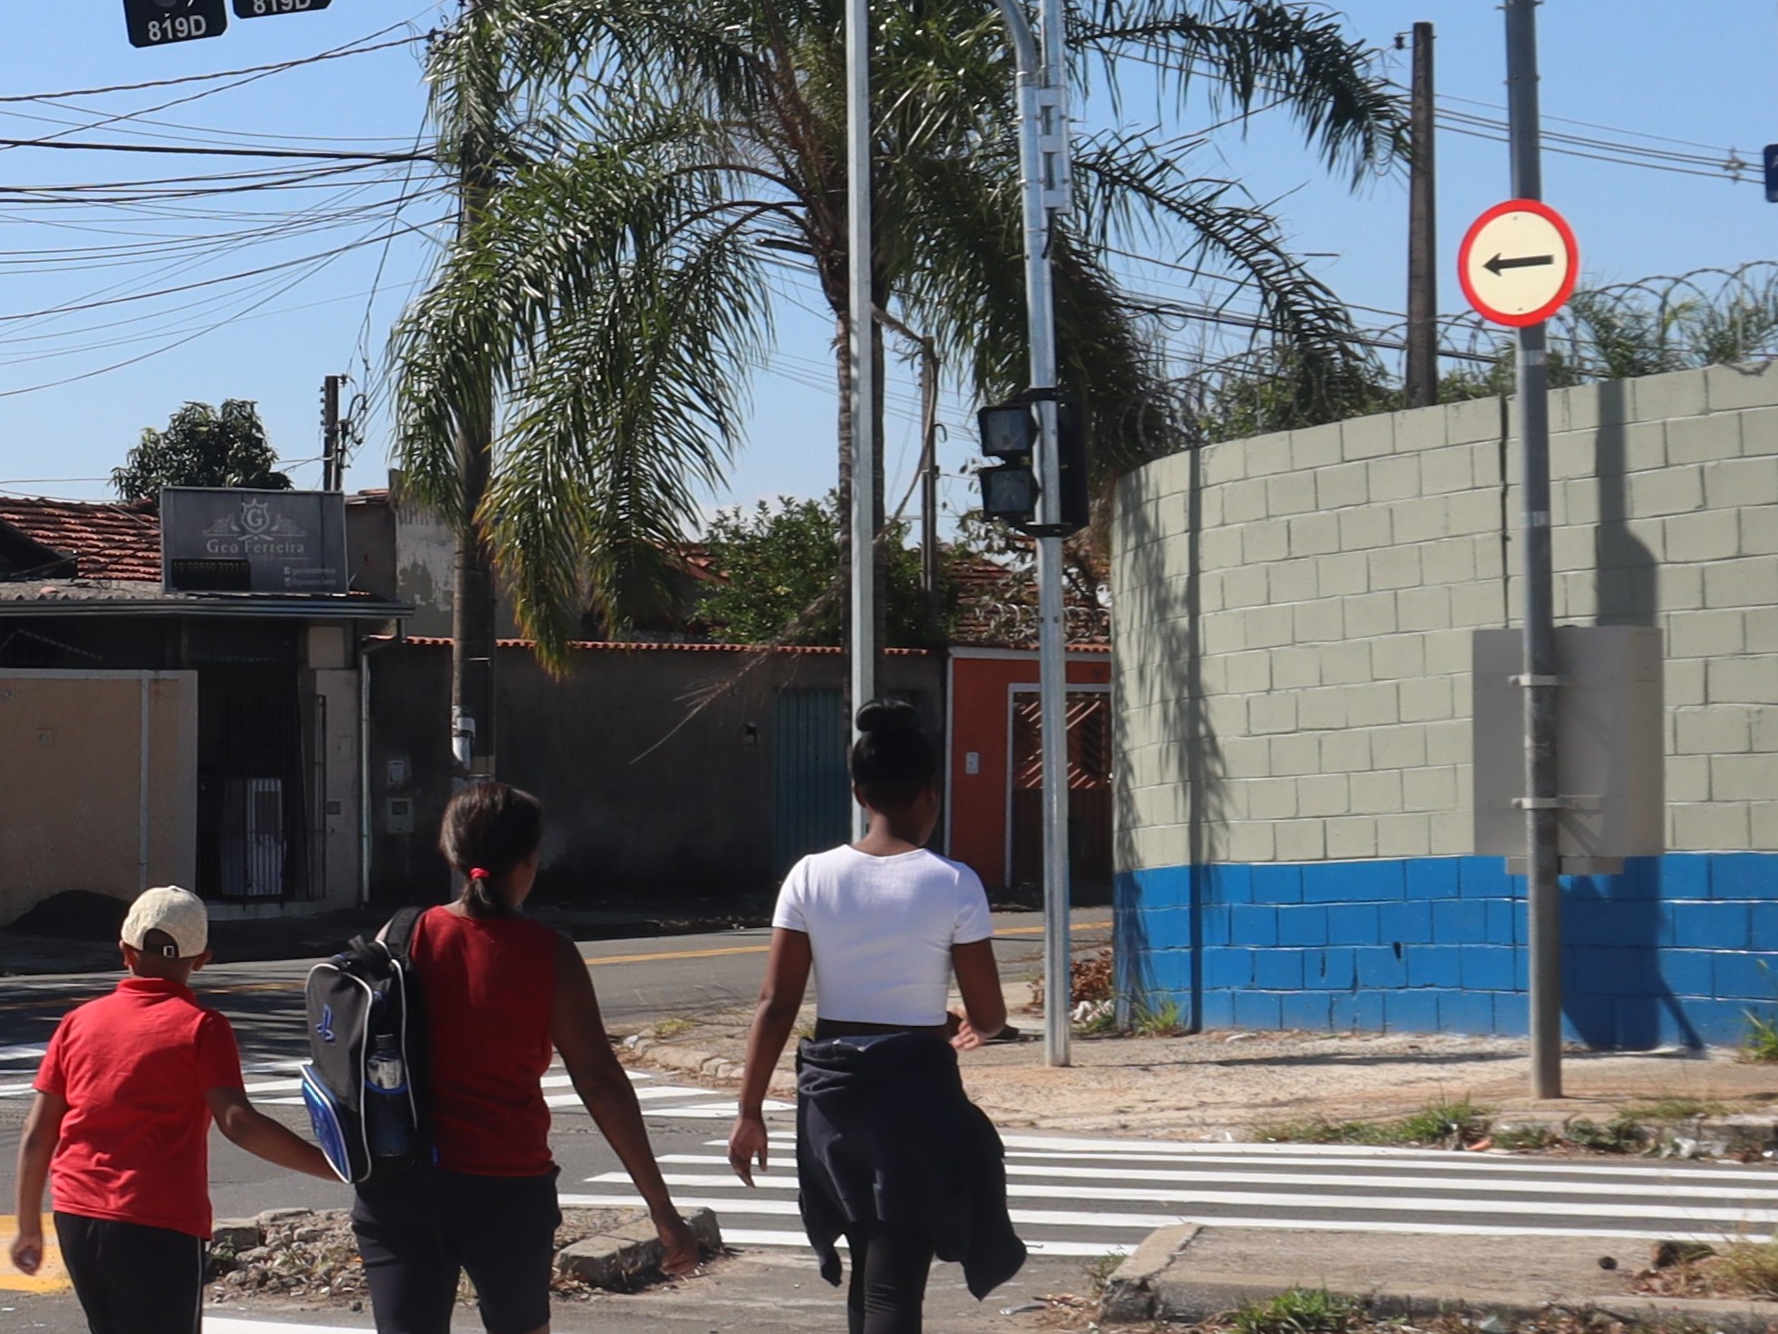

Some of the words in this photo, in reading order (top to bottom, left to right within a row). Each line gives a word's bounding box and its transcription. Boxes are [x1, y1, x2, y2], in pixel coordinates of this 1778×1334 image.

[147, 14, 207, 43] 819D
[246, 508, 264, 527] G
[206, 539, 238, 554] Geo
[244, 539, 305, 554] Ferreira
